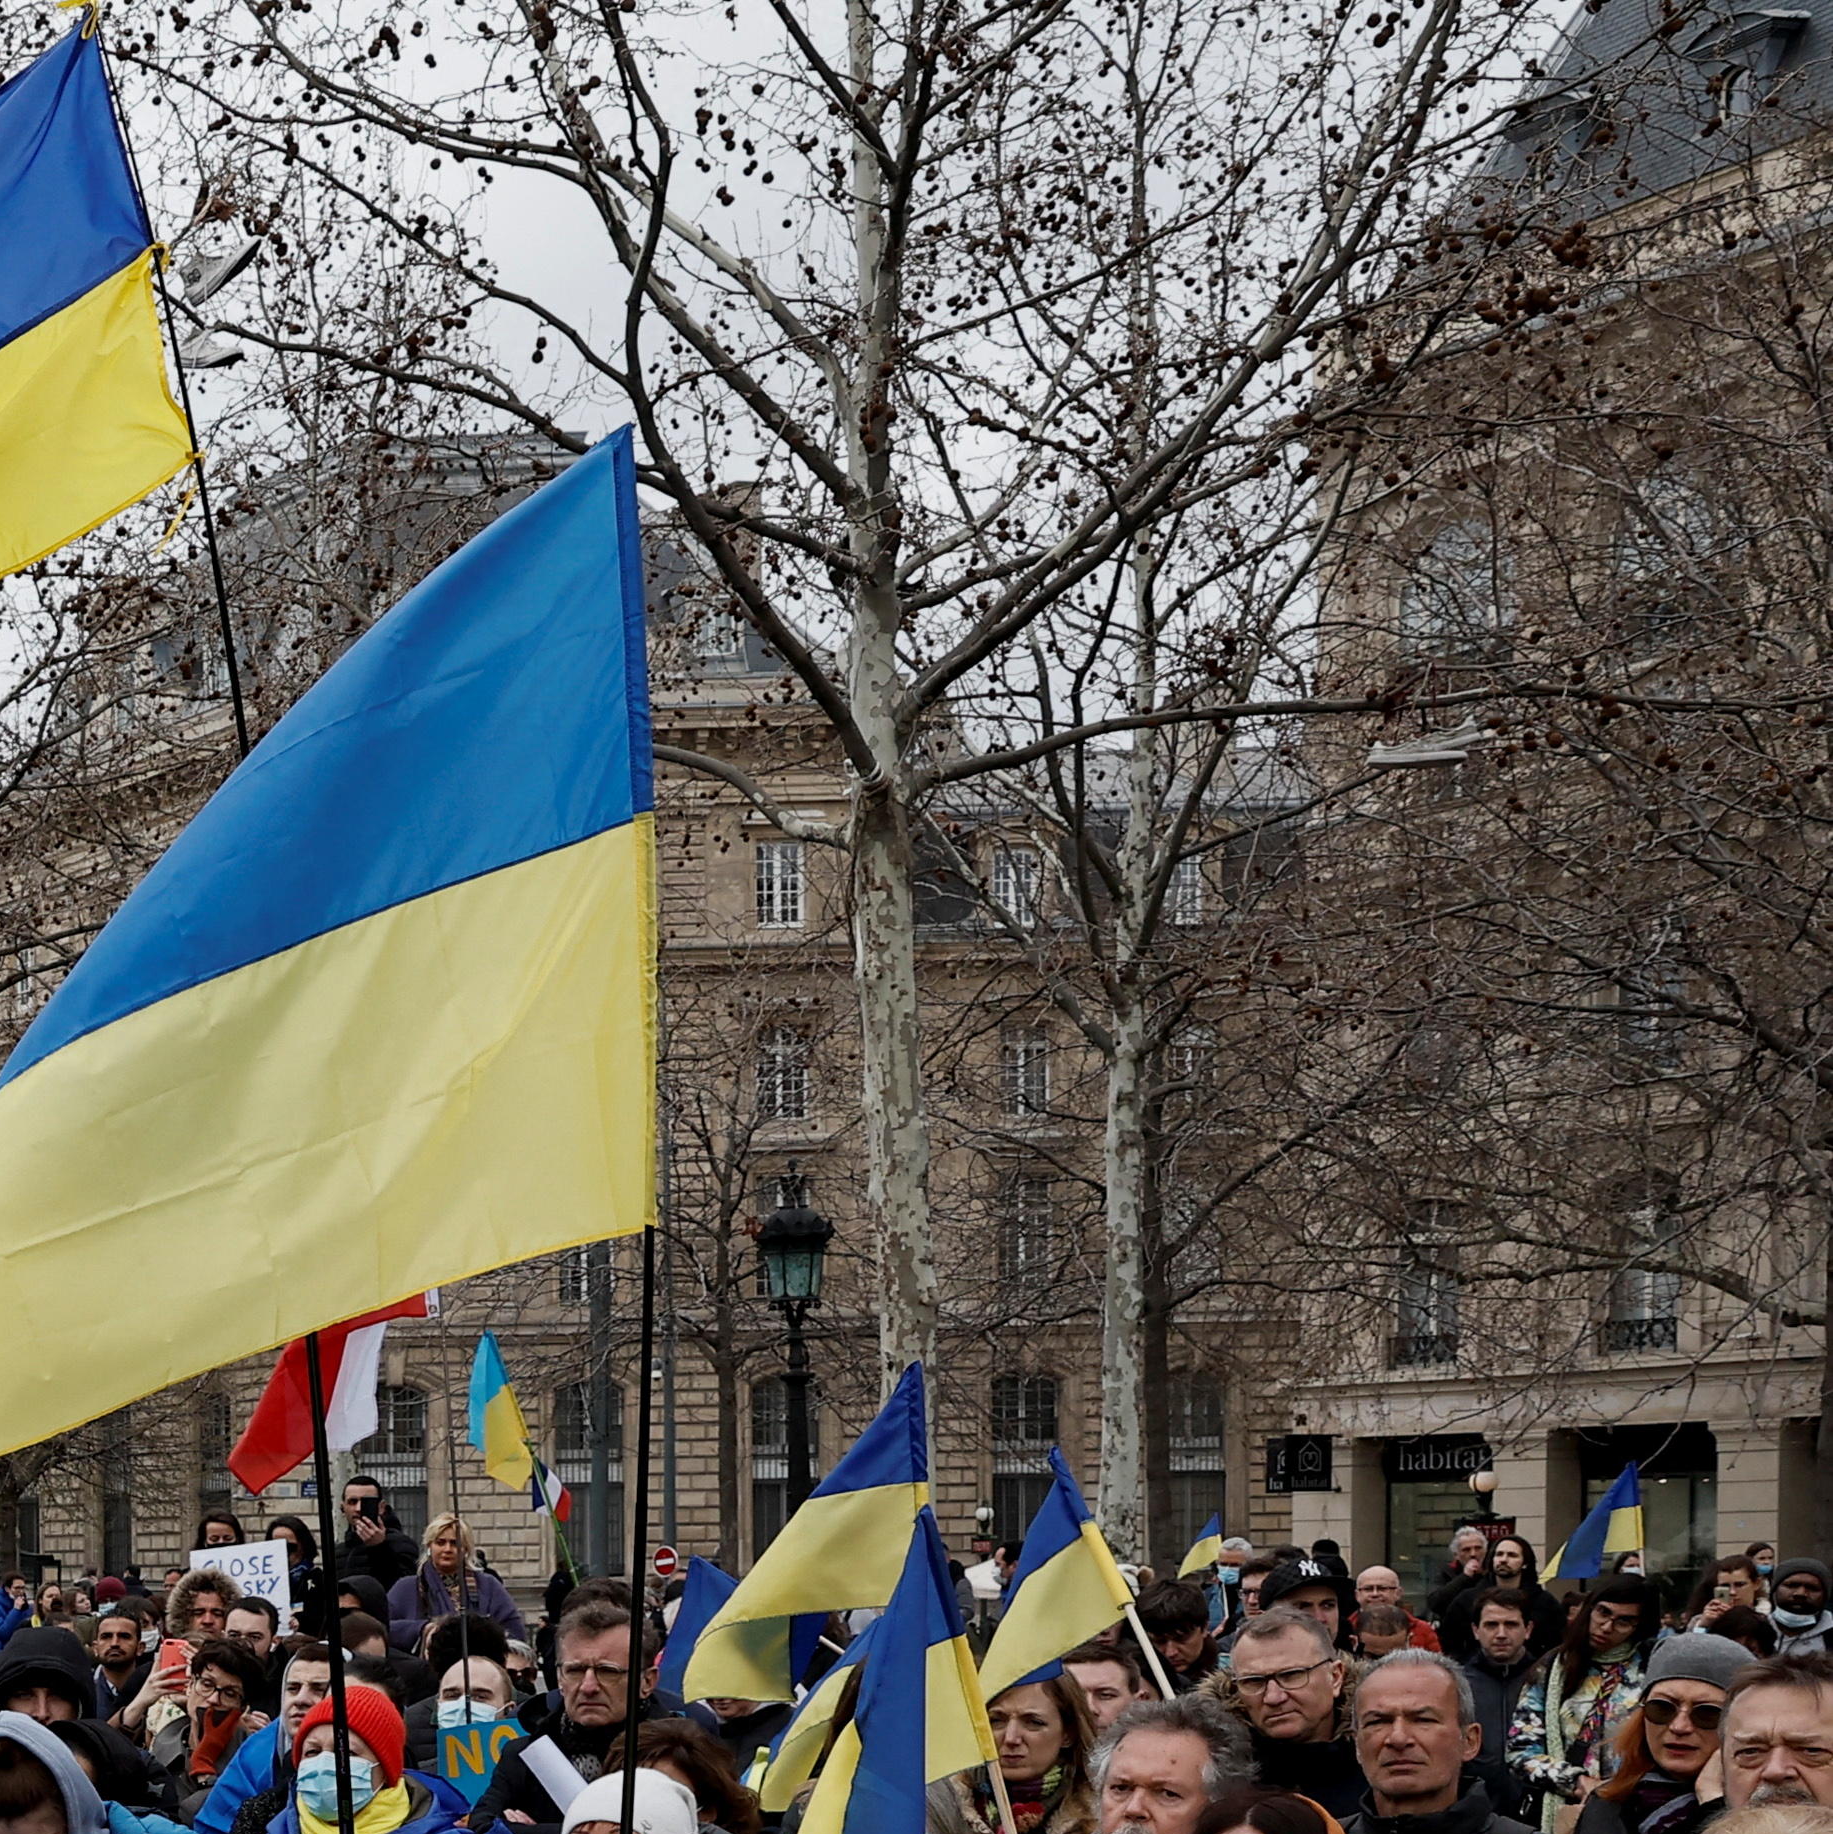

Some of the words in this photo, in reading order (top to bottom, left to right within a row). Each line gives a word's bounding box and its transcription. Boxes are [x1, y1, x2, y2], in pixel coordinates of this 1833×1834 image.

[1398, 1444, 1485, 1471] habitat
[1298, 1559, 1322, 1577] NY
[243, 1575, 282, 1597] SKY
